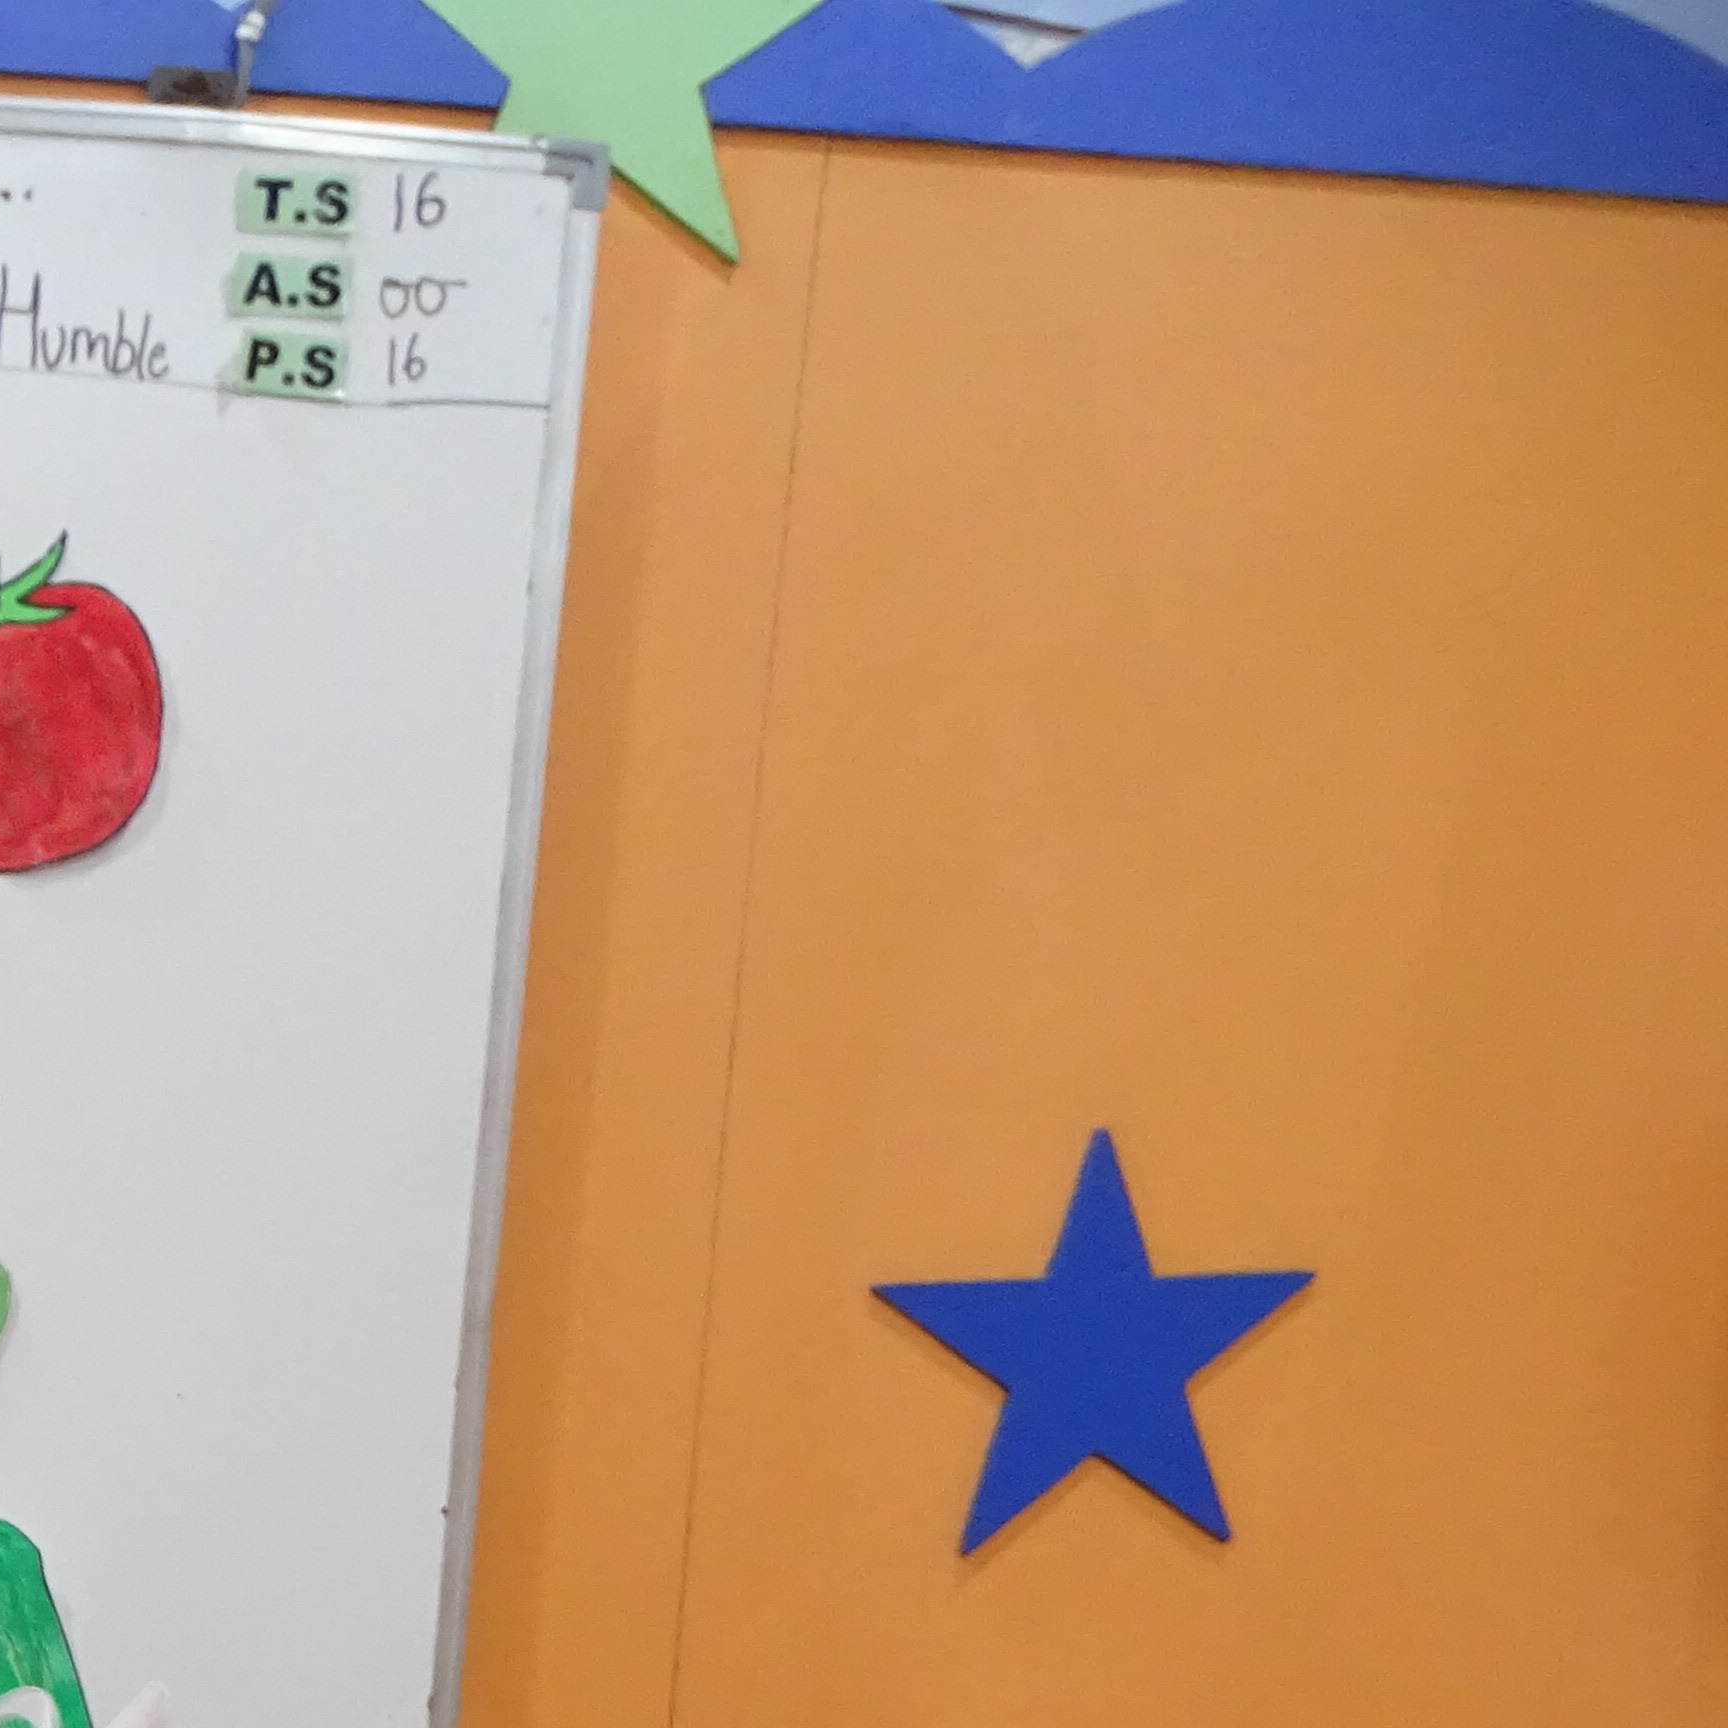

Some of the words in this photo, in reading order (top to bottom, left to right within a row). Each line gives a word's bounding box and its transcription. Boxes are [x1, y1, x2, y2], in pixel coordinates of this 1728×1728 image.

[255, 177, 349, 225] T.S
[393, 170, 446, 231] 16
[243, 261, 342, 308] A.S
[245, 338, 337, 389] P.S
[388, 332, 427, 385] 16
